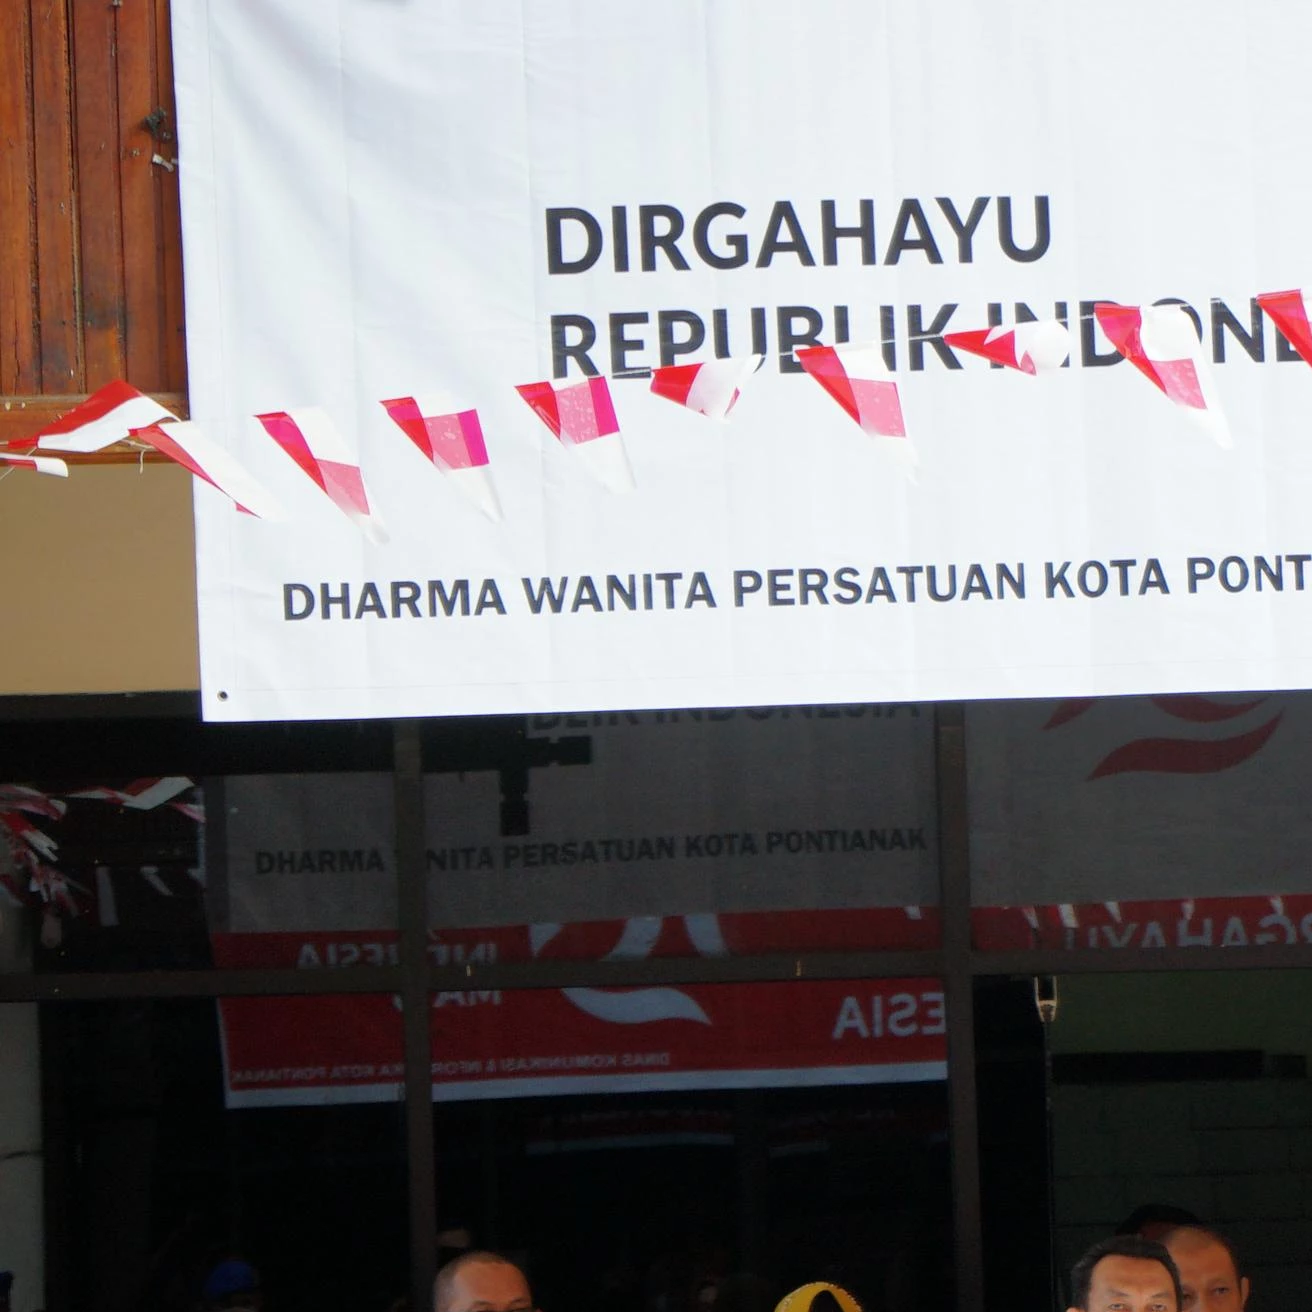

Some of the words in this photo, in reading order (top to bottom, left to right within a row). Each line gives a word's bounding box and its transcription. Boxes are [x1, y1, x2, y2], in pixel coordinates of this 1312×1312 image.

[545, 195, 1051, 275] DIRGAHAYU
[283, 578, 507, 621] DHARMA
[521, 571, 717, 615] WANITA
[732, 563, 1025, 607] PERSATUAN
[1044, 557, 1170, 599] KOTA
[255, 849, 385, 875] DHARMA
[396, 846, 494, 871] NITA
[503, 836, 675, 868] PERSATUAN
[685, 832, 758, 858] KOTA
[765, 828, 927, 854] PONTIANAK
